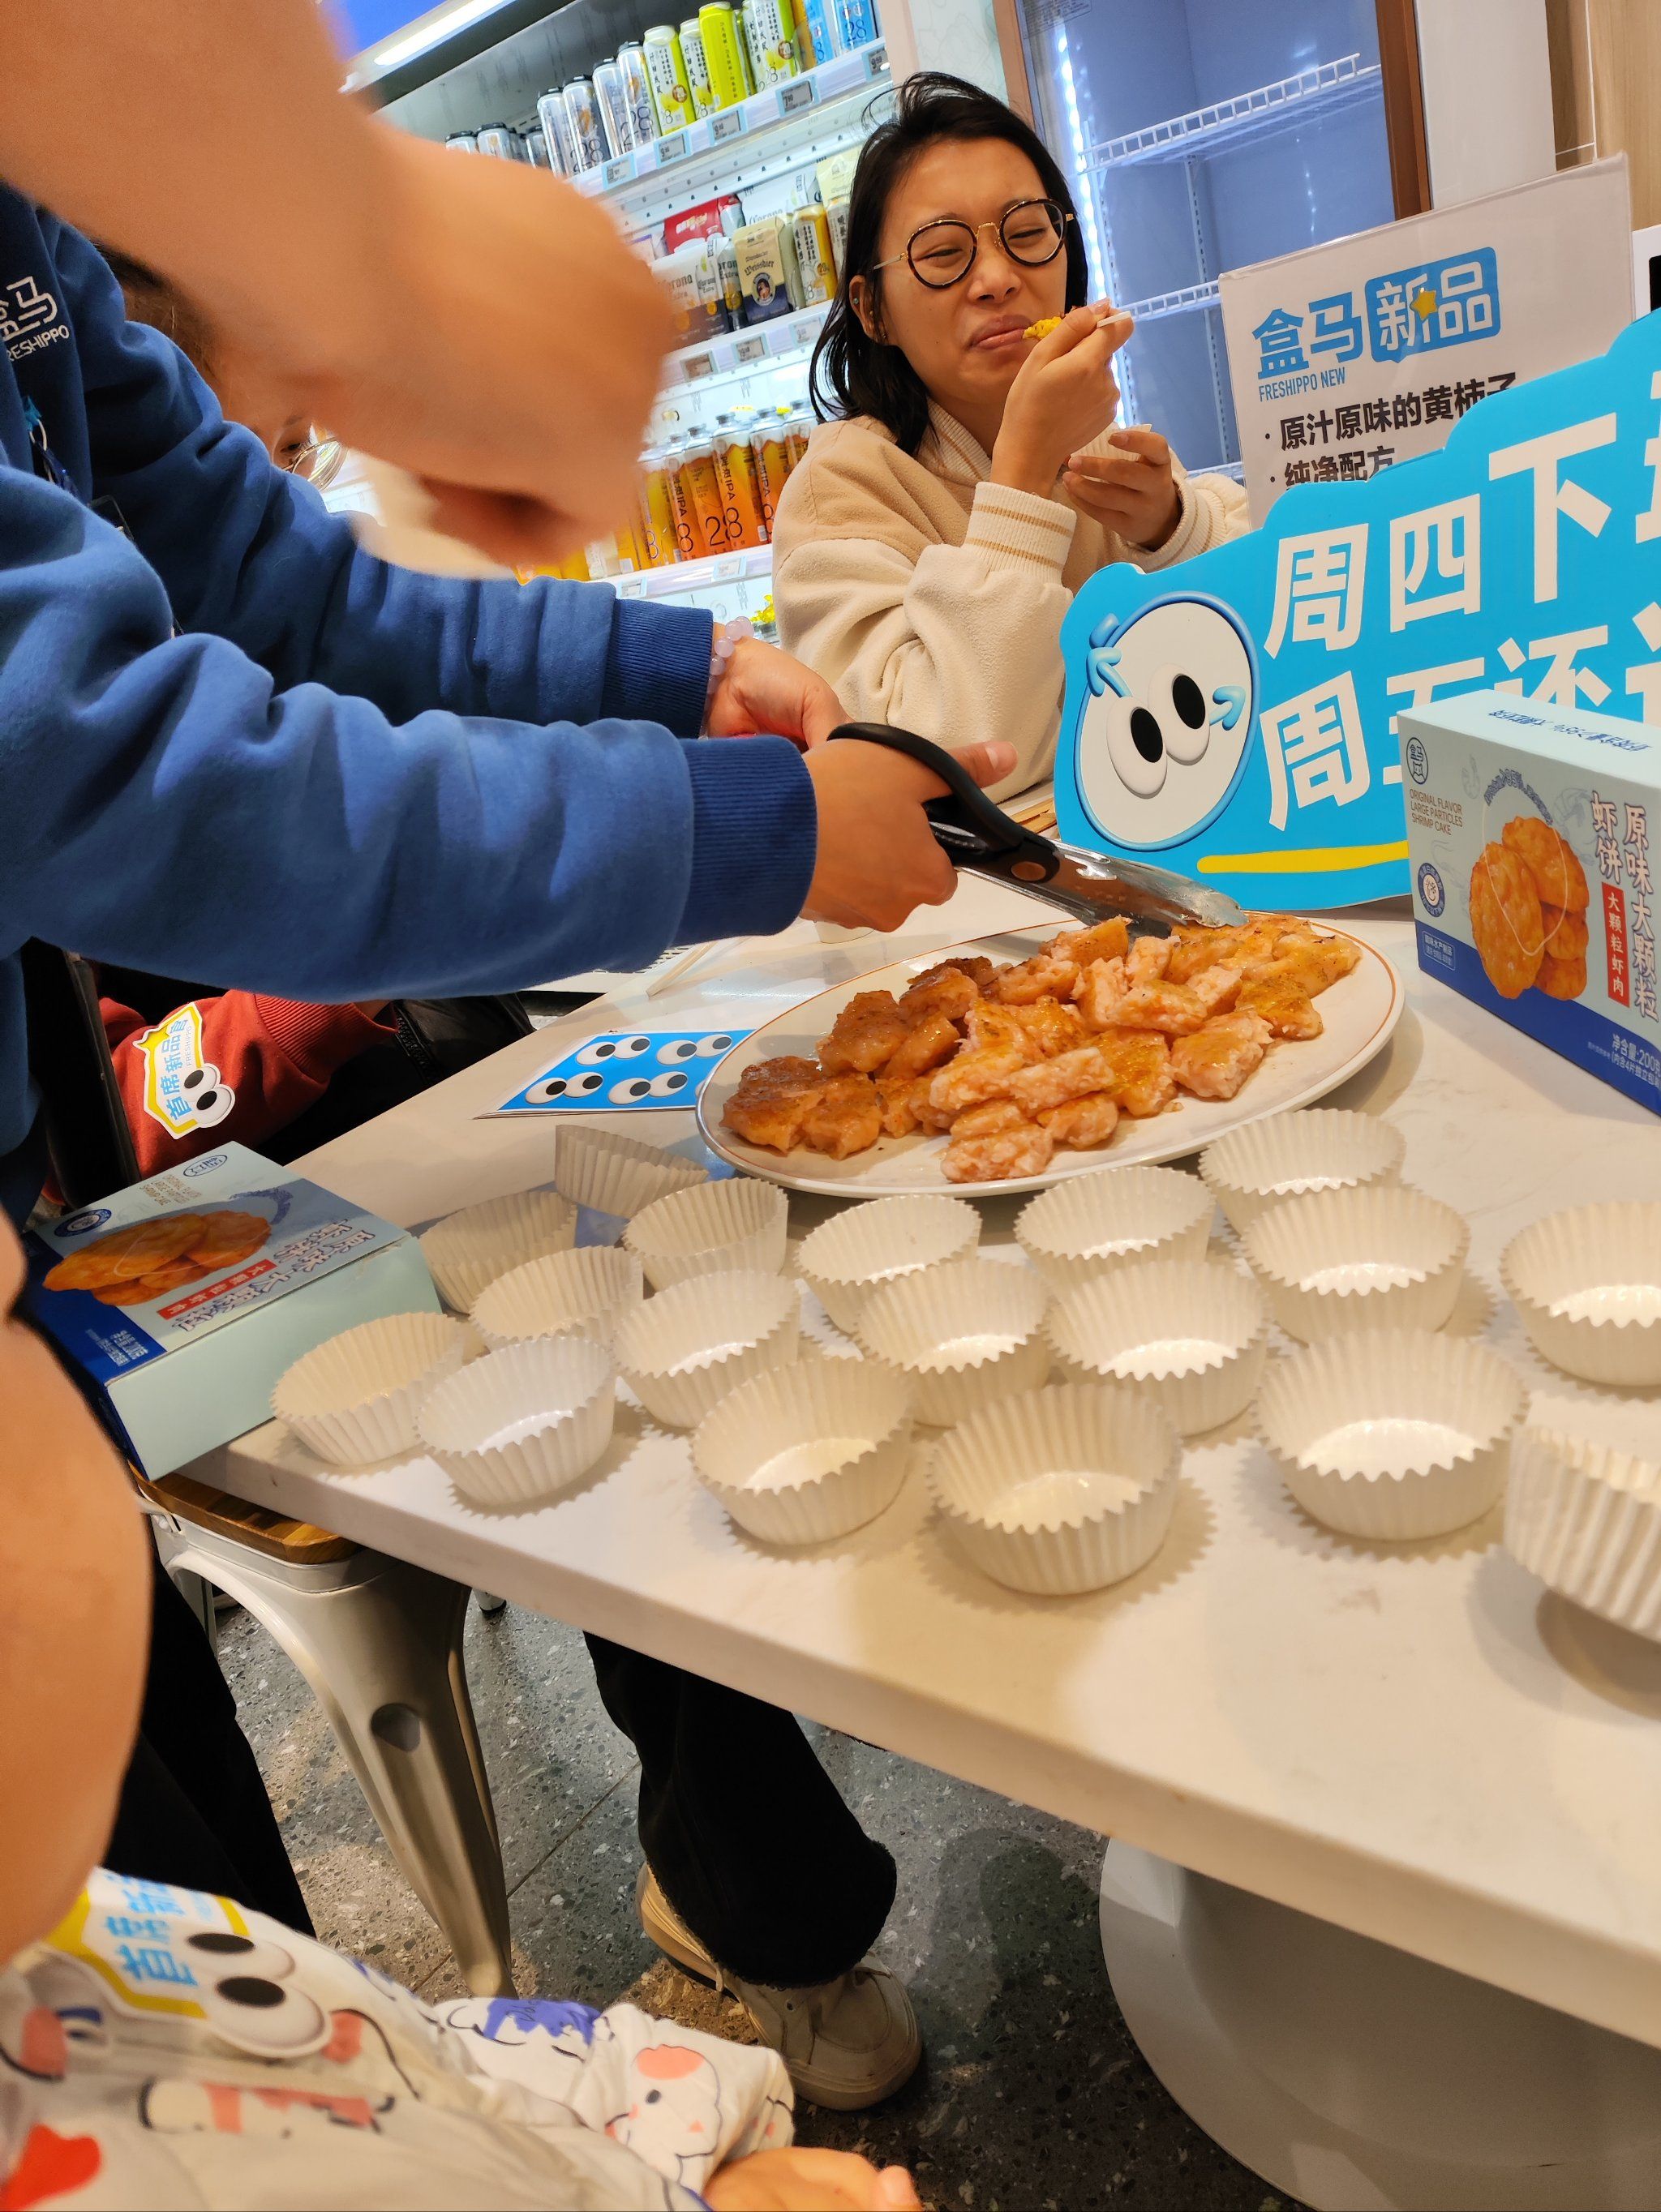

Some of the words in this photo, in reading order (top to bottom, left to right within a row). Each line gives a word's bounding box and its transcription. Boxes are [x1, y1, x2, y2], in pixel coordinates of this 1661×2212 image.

[6, 324, 70, 362] RESHIPPO
[1259, 373, 1318, 401] FRESHIPPO
[1320, 367, 1346, 388] NEW
[1410, 788, 1437, 808] ORIGINAL
[1437, 797, 1462, 815] FLAVOR
[1410, 800, 1430, 817] LARGE
[1430, 807, 1463, 827] PARTICLES
[1412, 812, 1434, 828] SHRIMP
[1435, 821, 1452, 836] CAKE
[1591, 791, 1624, 885] 虾饼
[1624, 803, 1659, 1022] 原味大颗粒
[1607, 891, 1624, 997] 大颗粒虾肉
[160, 1019, 193, 1121] 首席新品官
